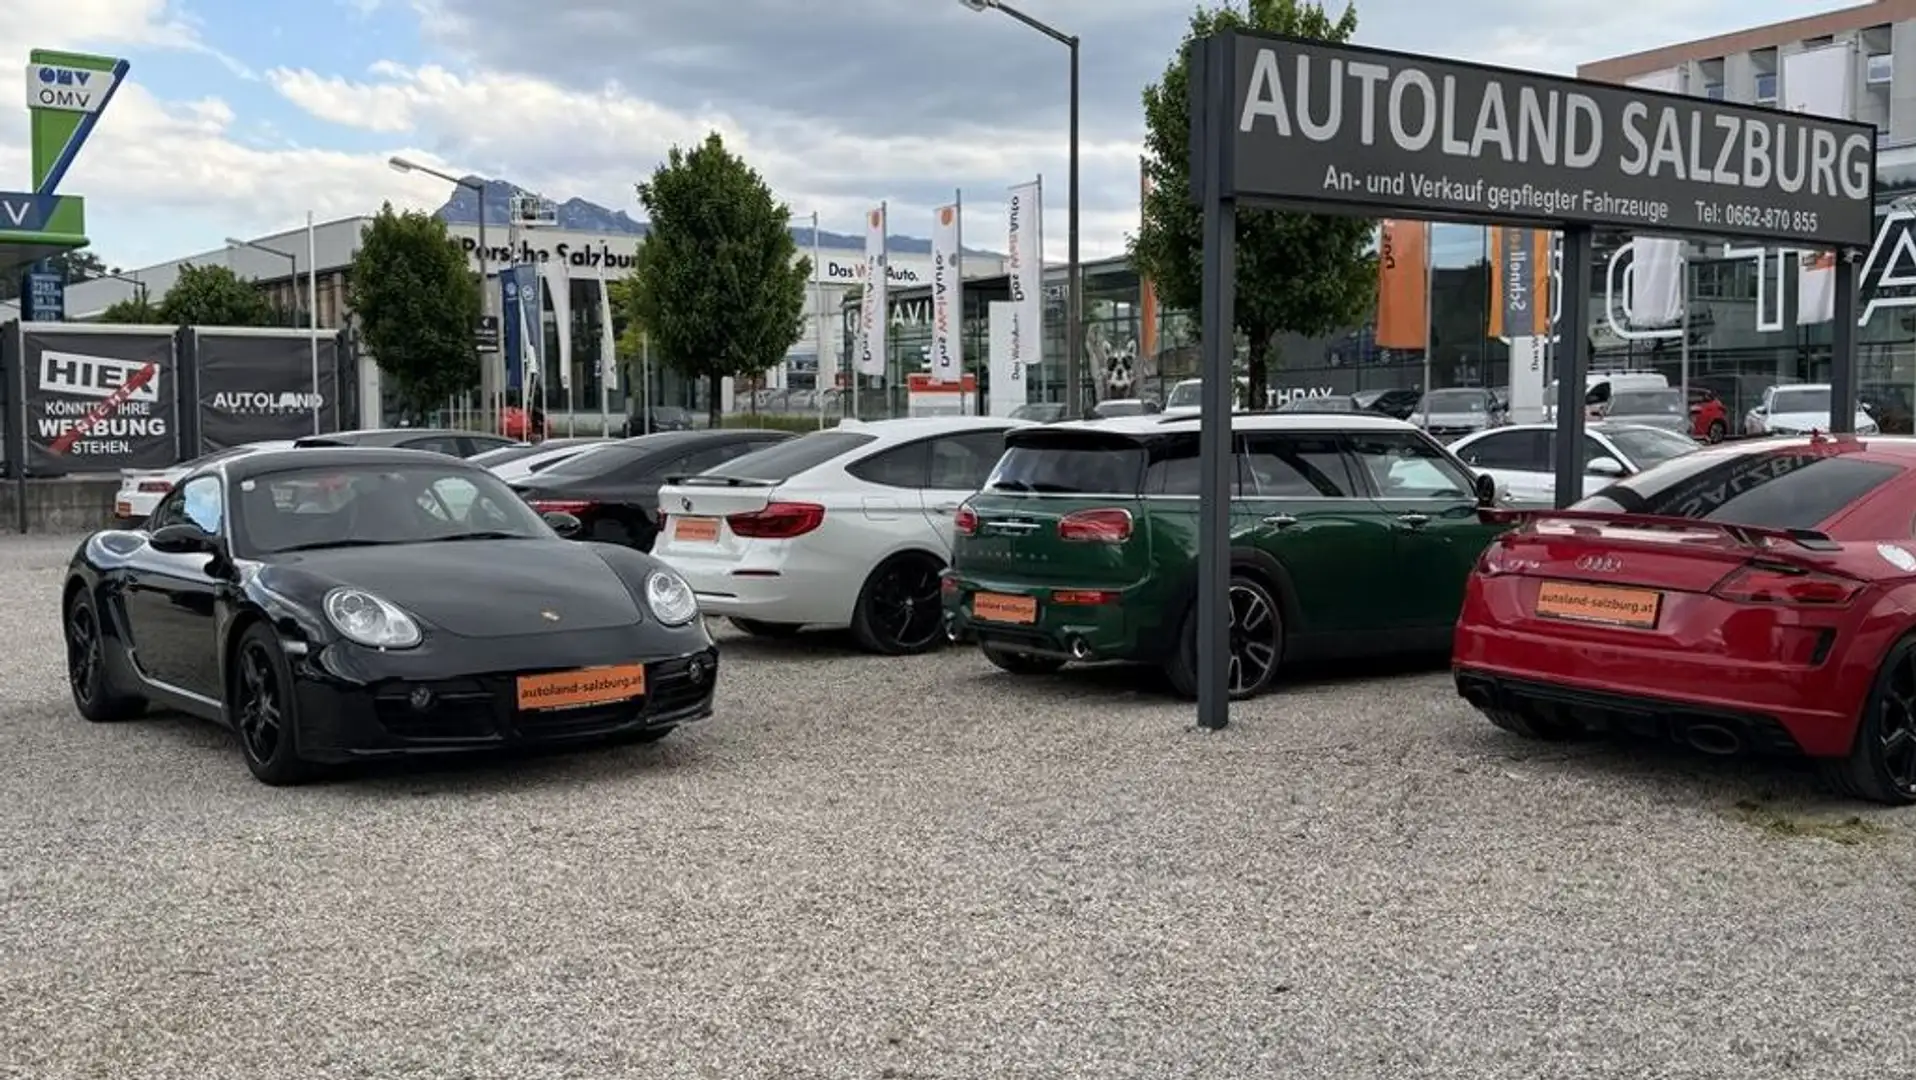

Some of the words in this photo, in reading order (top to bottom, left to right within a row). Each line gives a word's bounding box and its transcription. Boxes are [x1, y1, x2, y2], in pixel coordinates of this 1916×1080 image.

[39, 89, 91, 107] OMV
[1239, 48, 1603, 168] AUTOLAND
[1619, 101, 1871, 200] SALZBURG
[1323, 164, 1360, 191] An-
[1366, 172, 1405, 195] und
[1410, 173, 1484, 202] Verkauf
[1487, 183, 1578, 213] gepflegter
[1583, 190, 1669, 224] Fahrzeuge
[1695, 201, 1722, 223] Tel:
[1726, 204, 1789, 230] 0662-870
[1794, 211, 1818, 232] 855
[556, 243, 637, 268] Salzbur
[828, 261, 853, 278] Das
[72, 441, 133, 454] STEHEN.
[1541, 592, 1653, 614] autoland-salzburg.at
[521, 675, 642, 699] autoland-salzburg.at
